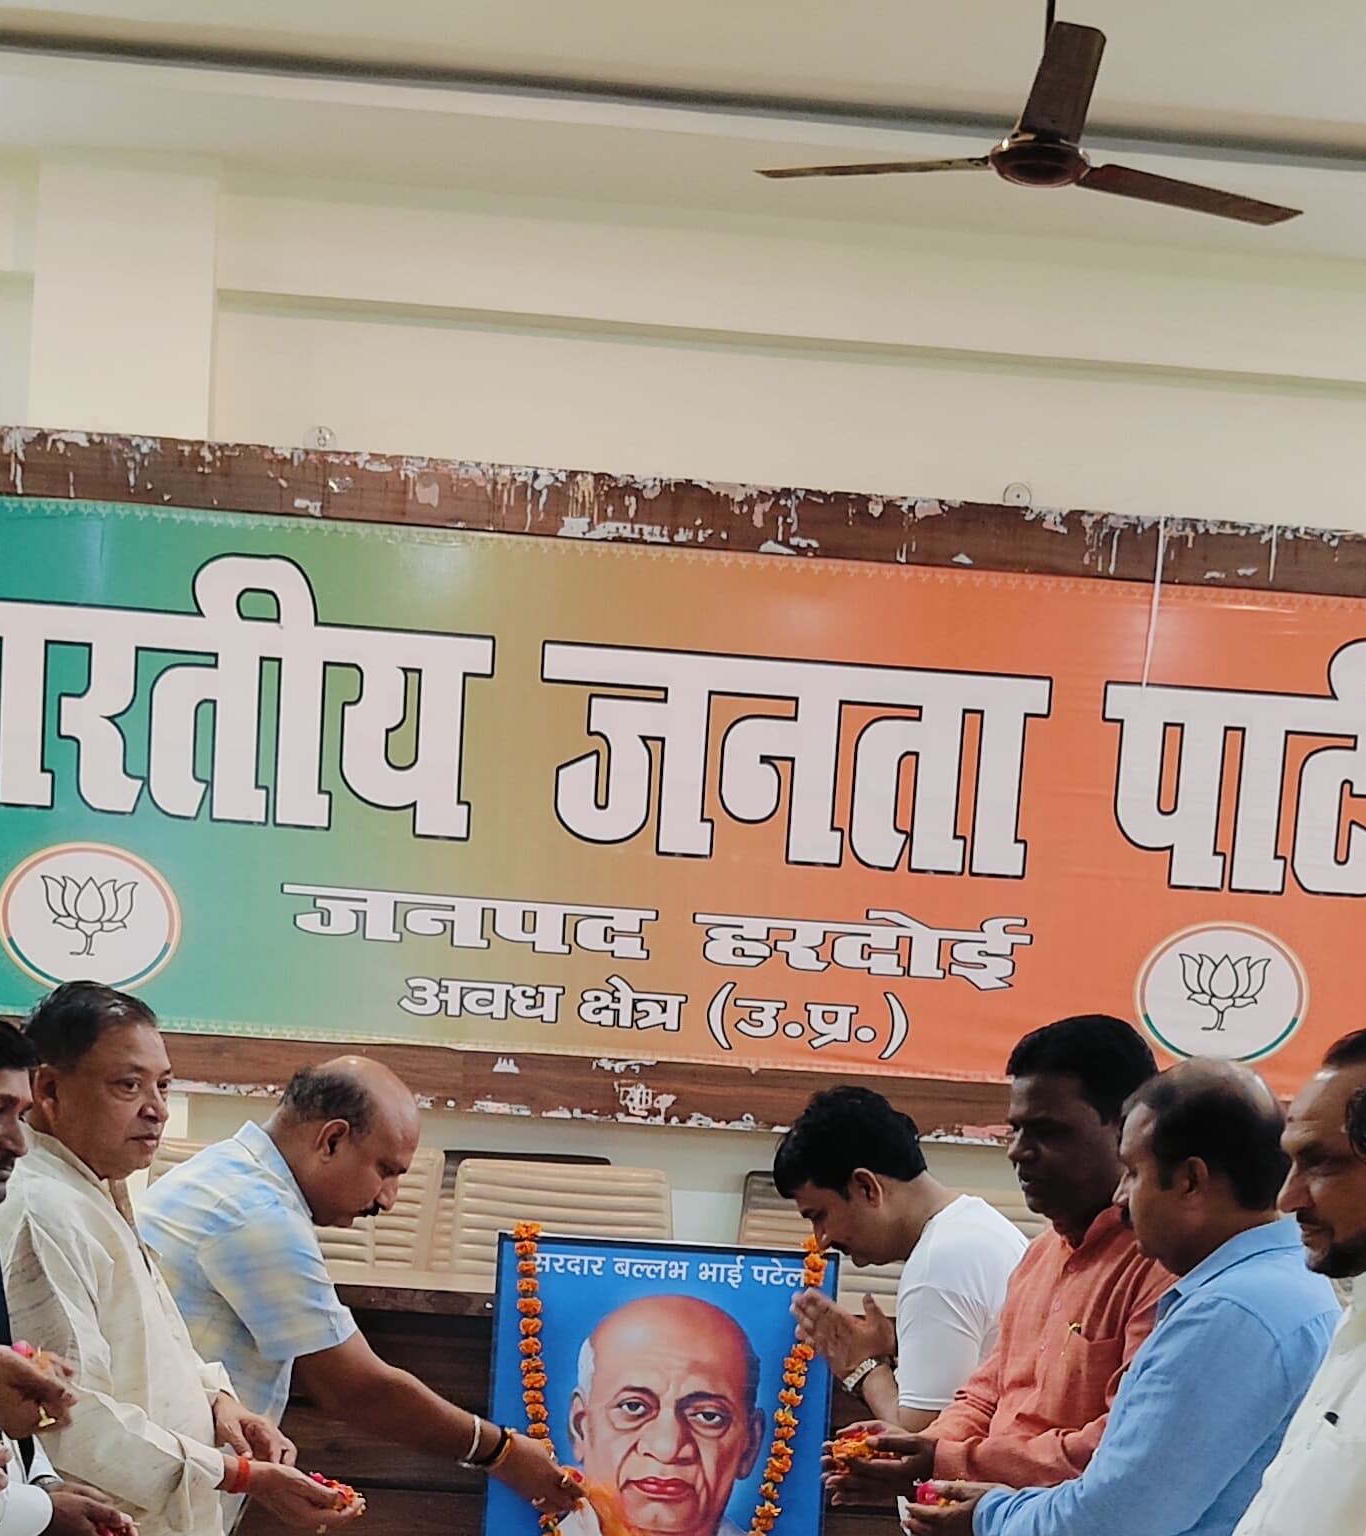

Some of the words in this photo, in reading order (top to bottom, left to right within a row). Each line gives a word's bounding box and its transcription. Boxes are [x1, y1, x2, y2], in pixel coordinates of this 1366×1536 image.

[541, 640, 1053, 879] जनता
[281, 882, 659, 960] जनपद
[691, 908, 1032, 990] हरदोई
[399, 976, 563, 1024] अवध
[577, 974, 687, 1033] क्षेत्र
[705, 981, 910, 1060] (उ.प्र.)
[533, 1252, 606, 1276] सरदार
[613, 1256, 688, 1281] बल्लभ
[698, 1255, 745, 1289] भाई
[751, 1258, 806, 1289] पटेल
